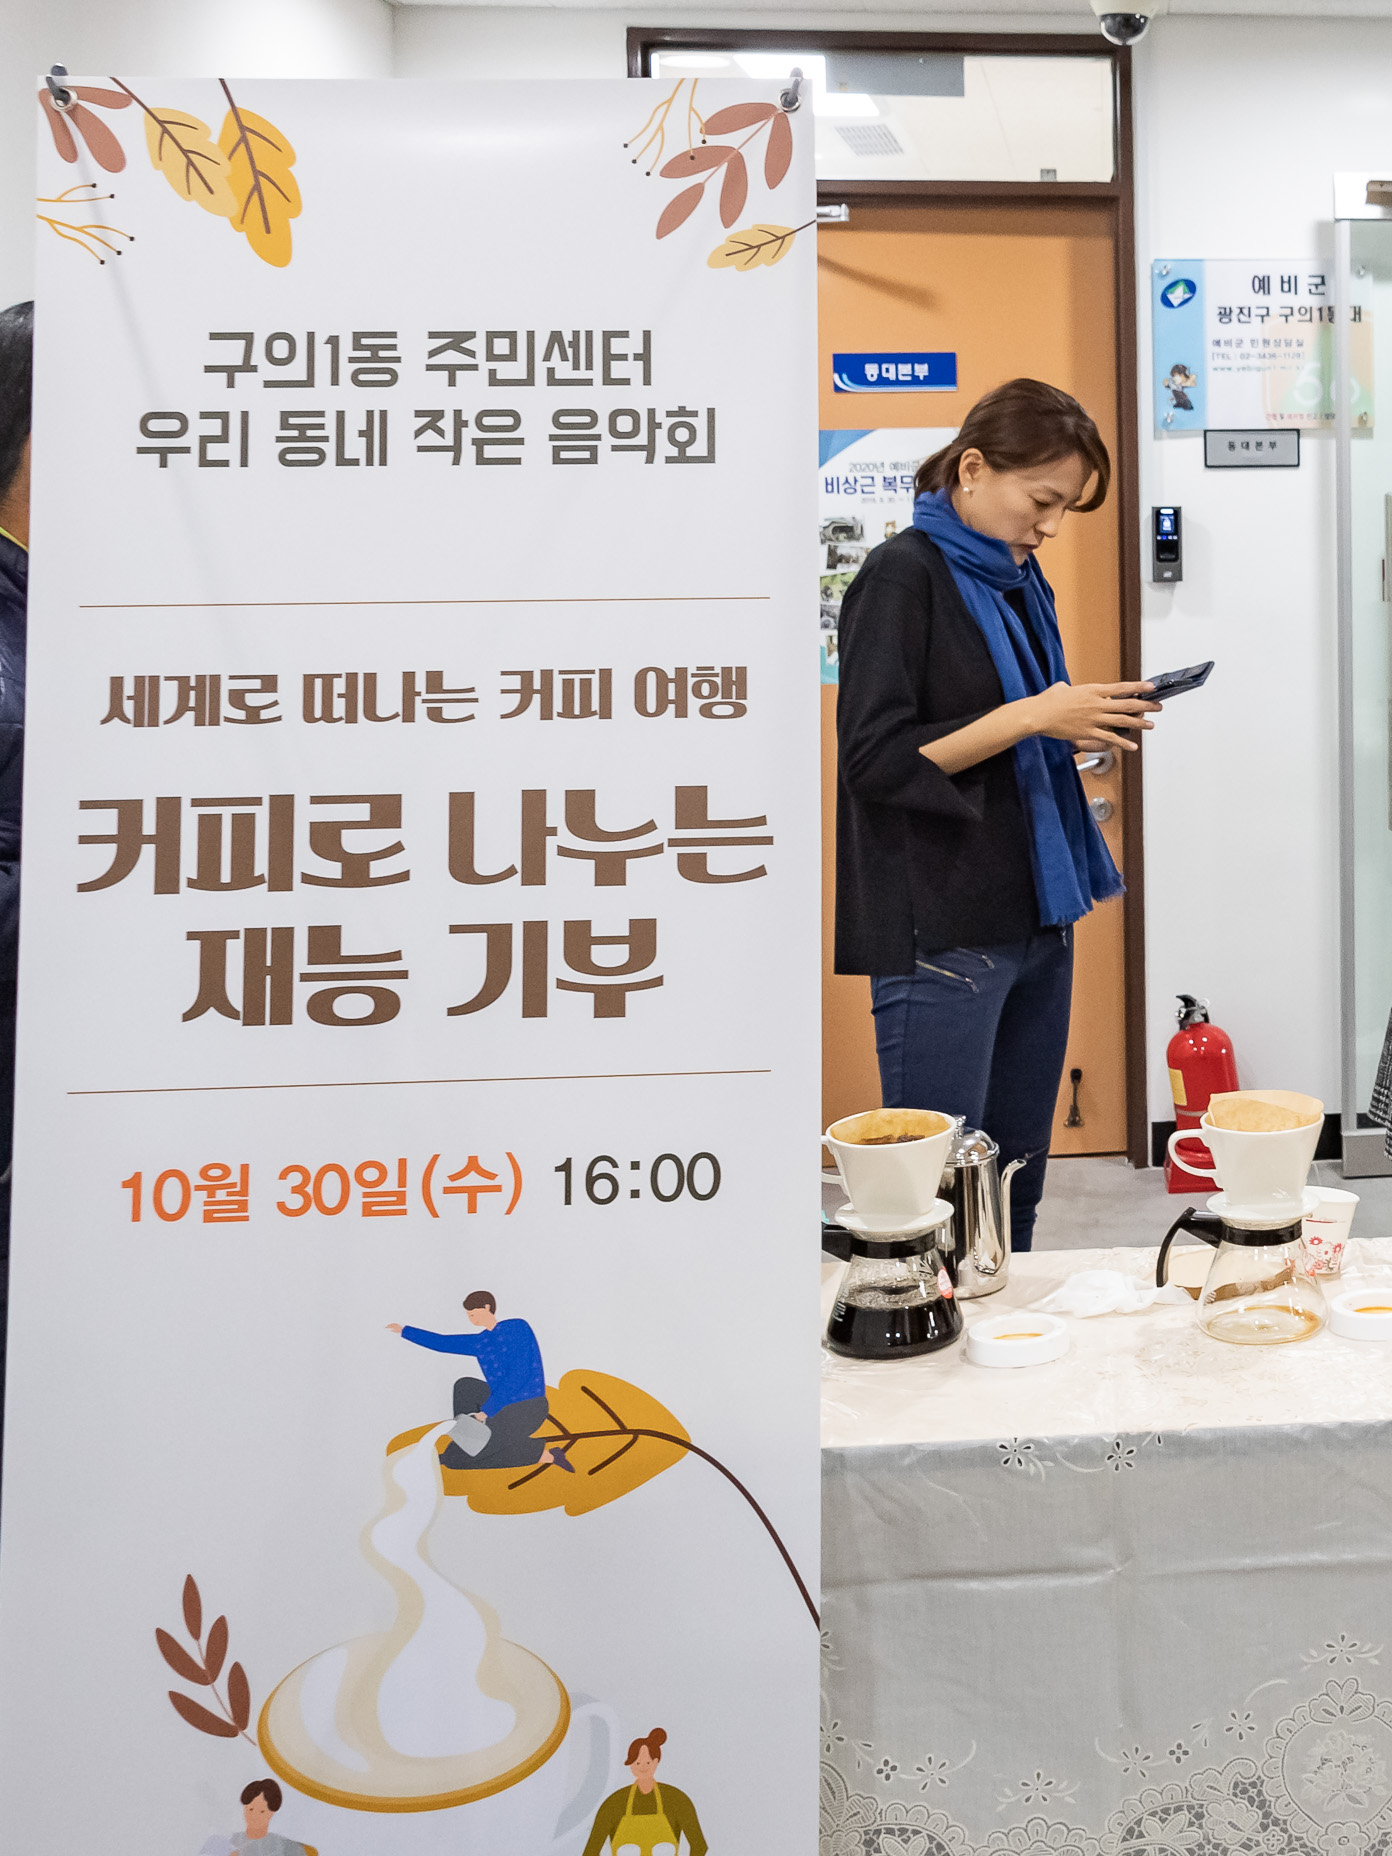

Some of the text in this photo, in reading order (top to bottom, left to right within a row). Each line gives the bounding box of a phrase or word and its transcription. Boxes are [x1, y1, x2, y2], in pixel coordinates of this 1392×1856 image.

[1252, 275, 1327, 296] 예비군
[1217, 305, 1271, 323] 광진구
[204, 330, 651, 388] 구의1동 주민센터
[864, 362, 929, 382] 동대본부
[136, 406, 715, 468] 우리 동네 작은 음악회
[1228, 440, 1277, 452] 동대본부
[825, 475, 876, 495] 비상근
[849, 462, 885, 474] 2020년
[100, 666, 747, 728] 세계로 떠나는 커피 여행
[77, 785, 774, 895] 커피로 나누는
[182, 918, 664, 1026] 재능 기부
[121, 1152, 721, 1223] 10월 30일(수) 16:00
